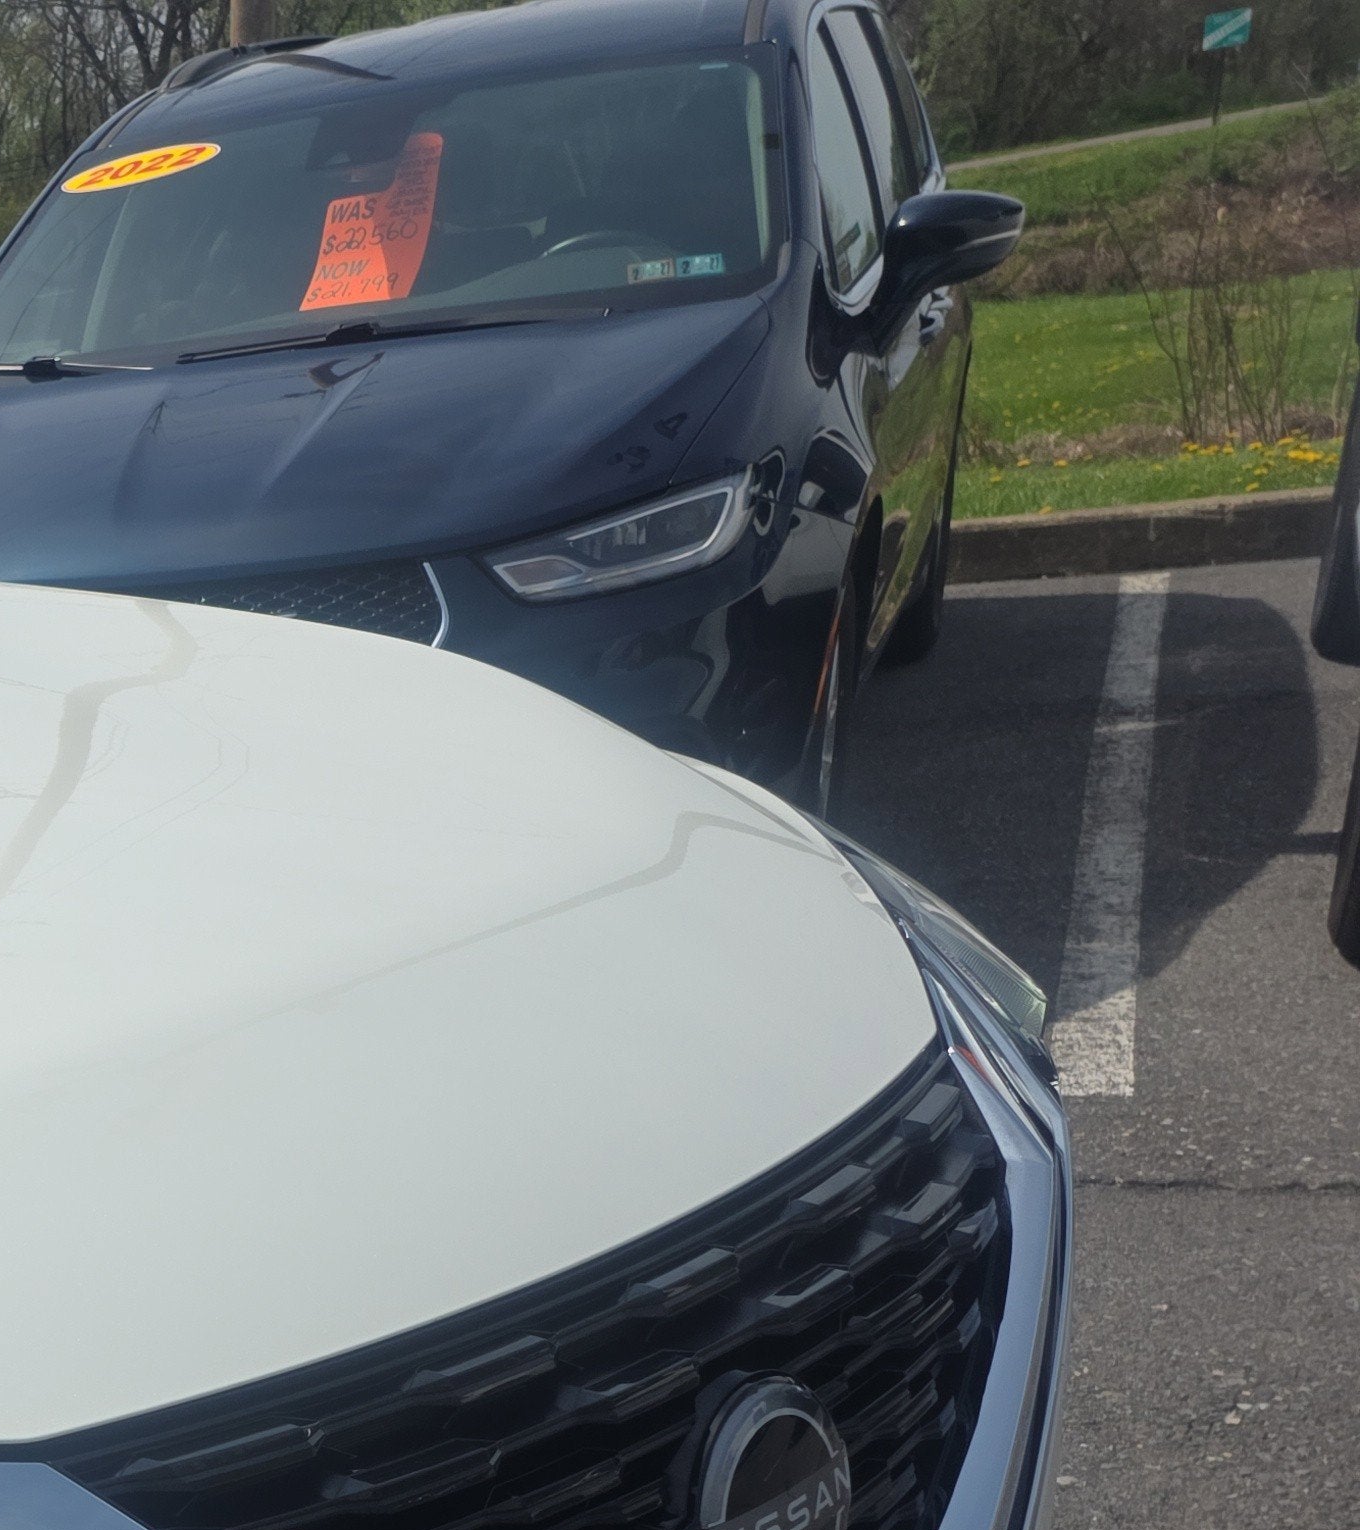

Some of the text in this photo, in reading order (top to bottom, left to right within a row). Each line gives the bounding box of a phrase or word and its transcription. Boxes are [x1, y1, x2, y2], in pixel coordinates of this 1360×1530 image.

[75, 146, 207, 190] 2022
[329, 198, 378, 225] WAS
[315, 258, 371, 282] NOW
